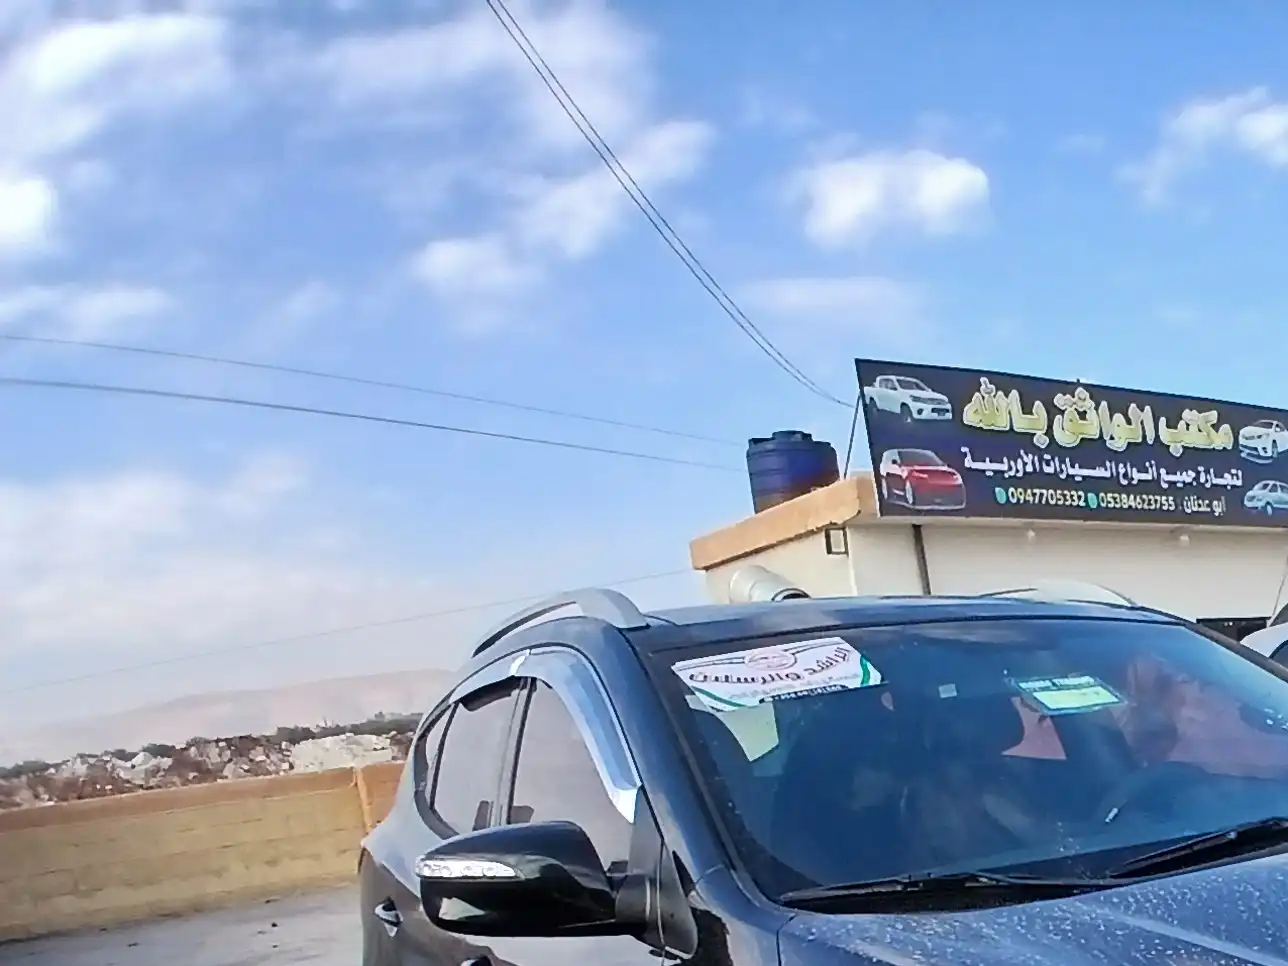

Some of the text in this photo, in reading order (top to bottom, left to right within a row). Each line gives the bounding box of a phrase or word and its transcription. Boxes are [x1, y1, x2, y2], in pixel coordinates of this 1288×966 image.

[962, 377, 1234, 457] مكتب الواثق بالله
[1042, 454, 1117, 482] السيارات
[1159, 467, 1197, 489] جميع
[1197, 465, 1243, 490] لتجارة
[1008, 486, 1086, 507] 0947705332
[1098, 492, 1176, 511] 05384623755
